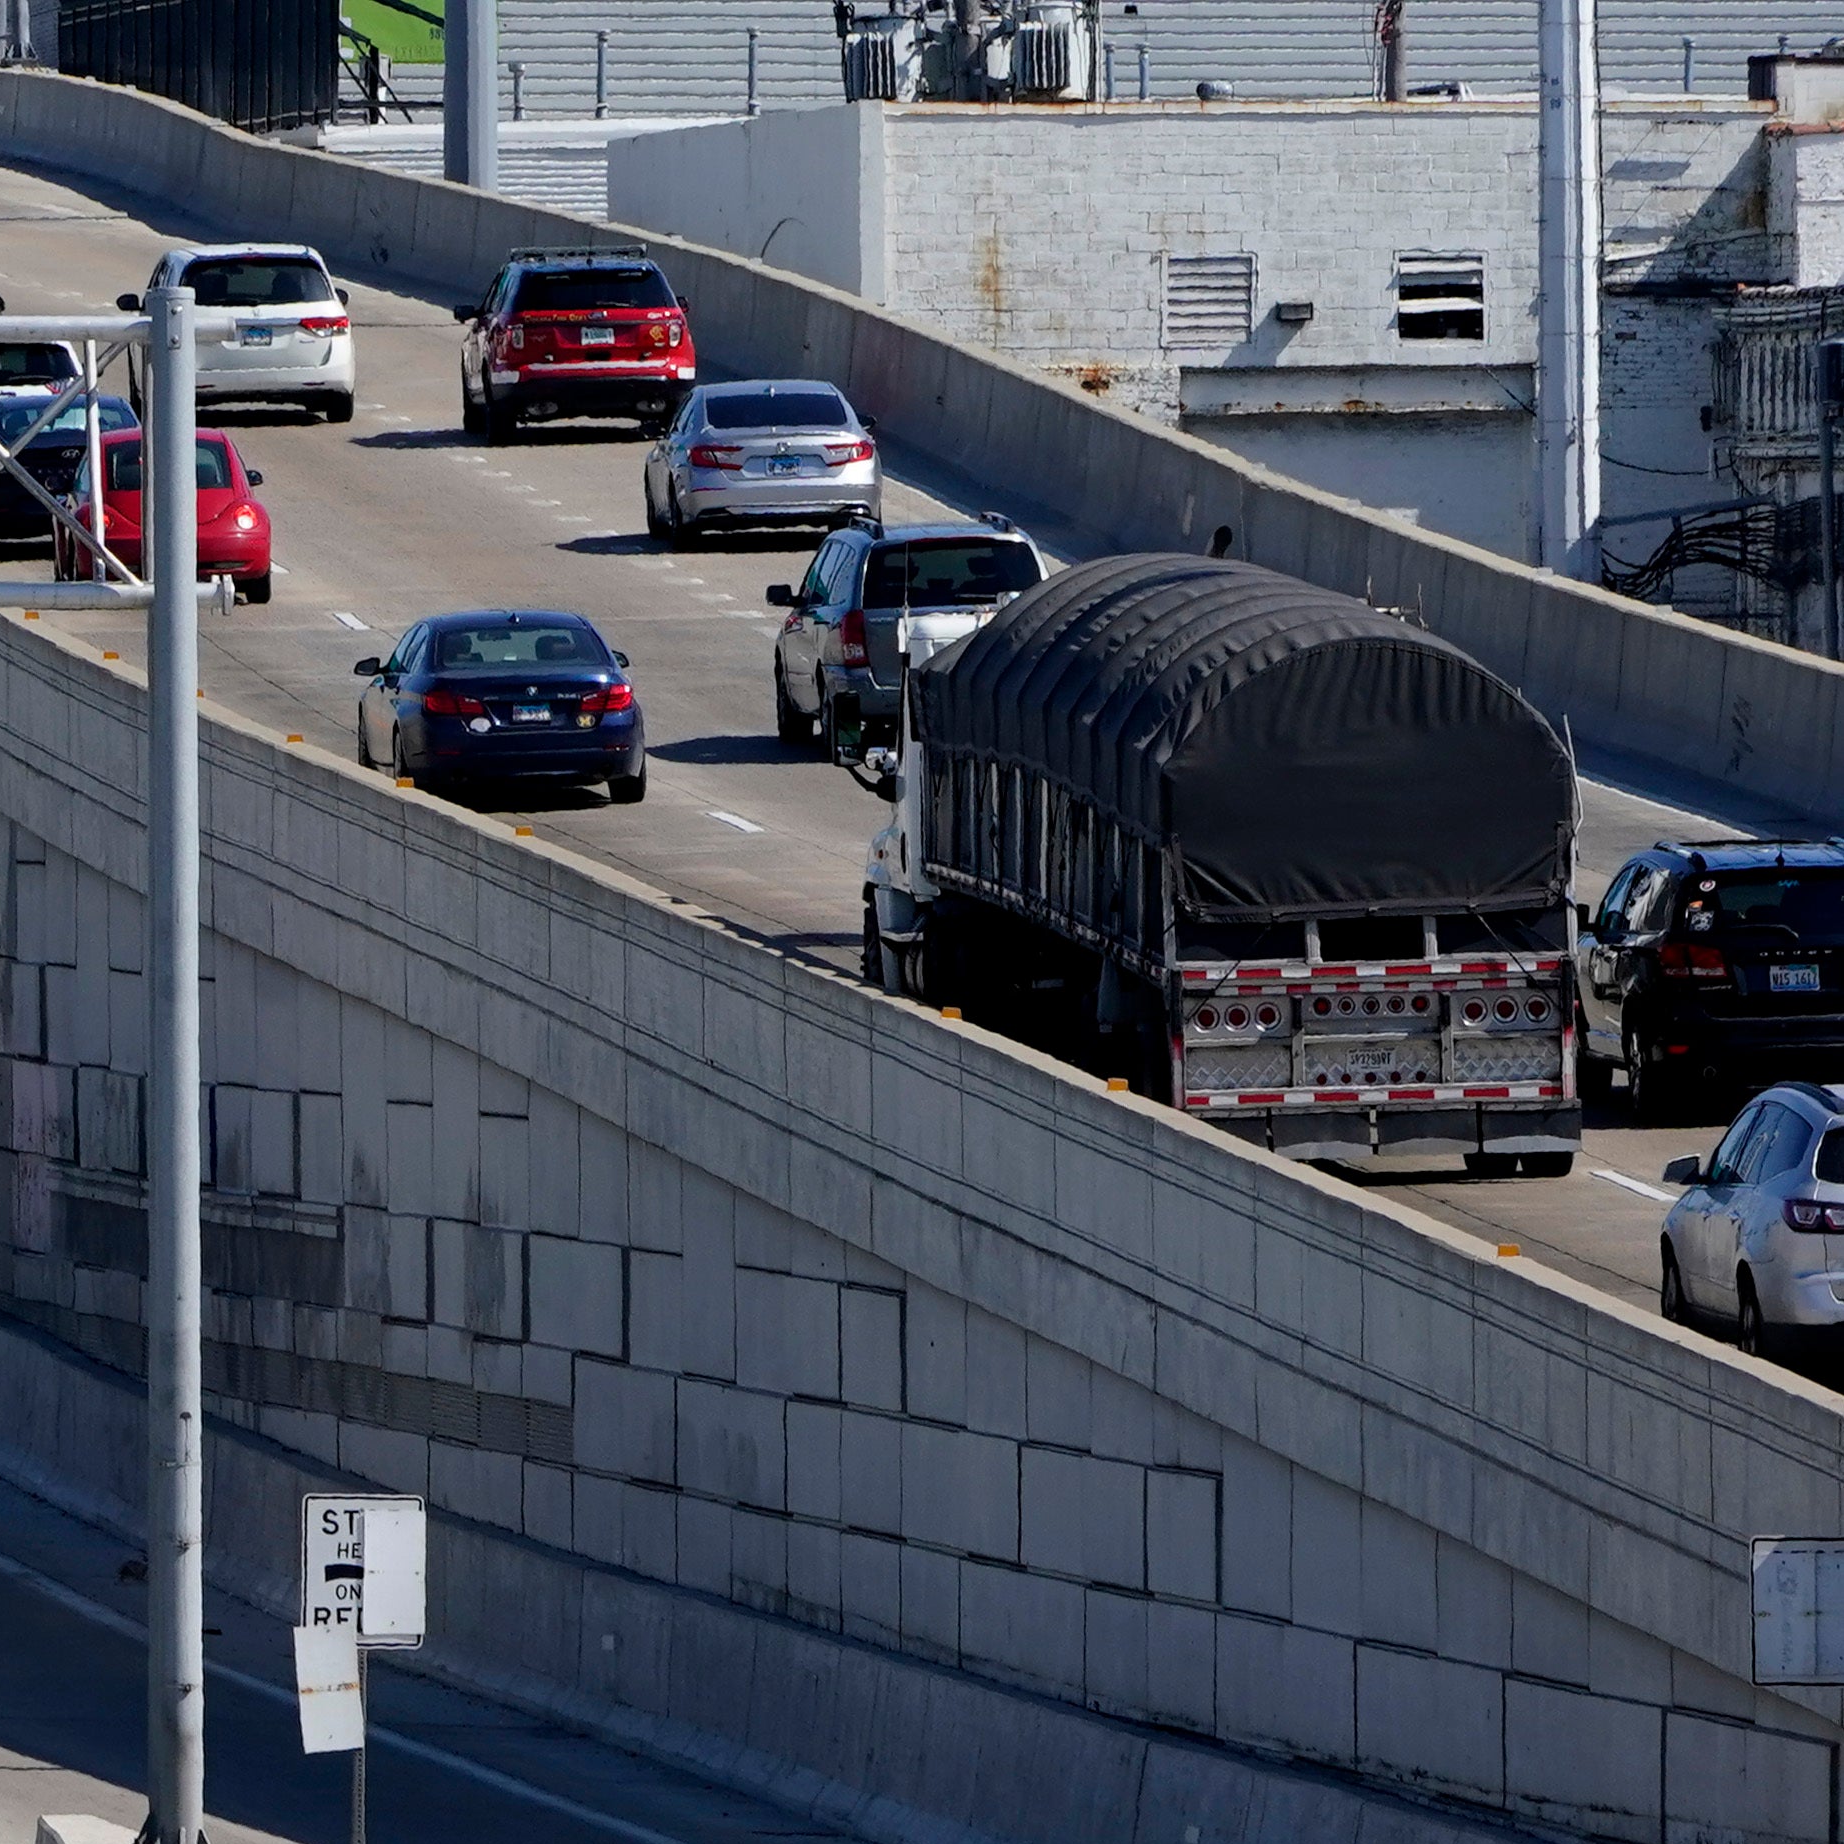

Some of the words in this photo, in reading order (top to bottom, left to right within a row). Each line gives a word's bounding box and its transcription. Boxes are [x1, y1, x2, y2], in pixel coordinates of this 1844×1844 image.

[321, 1509, 359, 1535] ST
[337, 1542, 362, 1559] HE
[335, 1584, 362, 1600] ON
